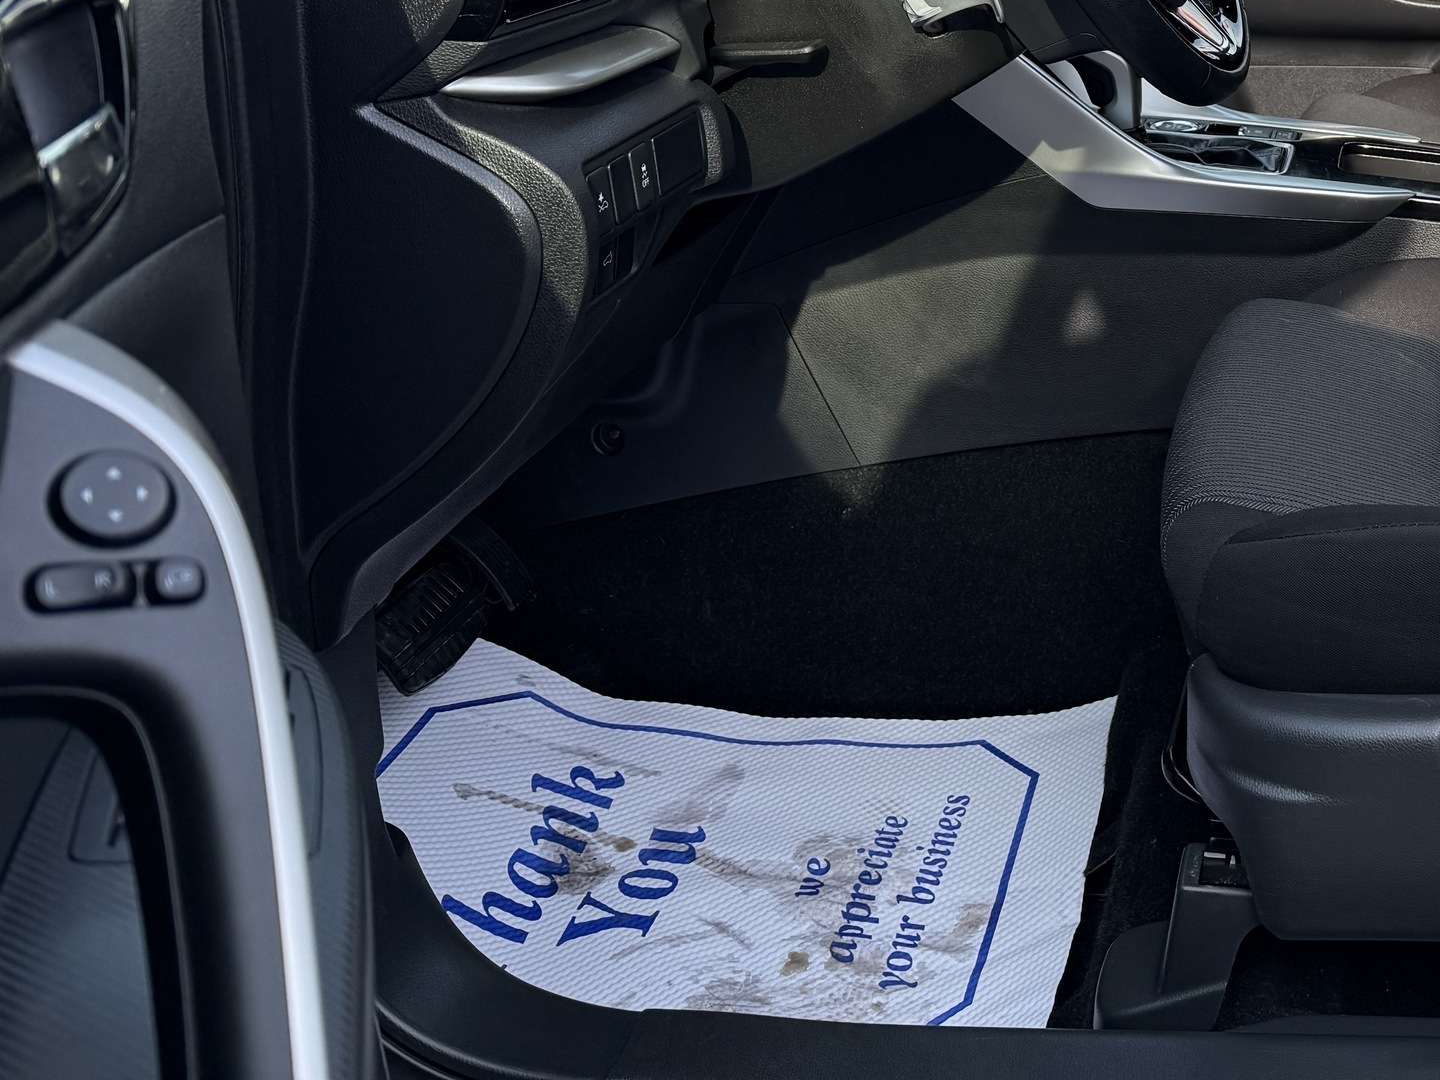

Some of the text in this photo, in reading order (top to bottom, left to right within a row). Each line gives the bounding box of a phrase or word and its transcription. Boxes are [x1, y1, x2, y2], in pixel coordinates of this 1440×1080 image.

[441, 765, 625, 946] hank
[556, 825, 706, 947] You
[794, 857, 831, 897] we
[829, 815, 909, 964] appreciate
[878, 794, 970, 990] your business
